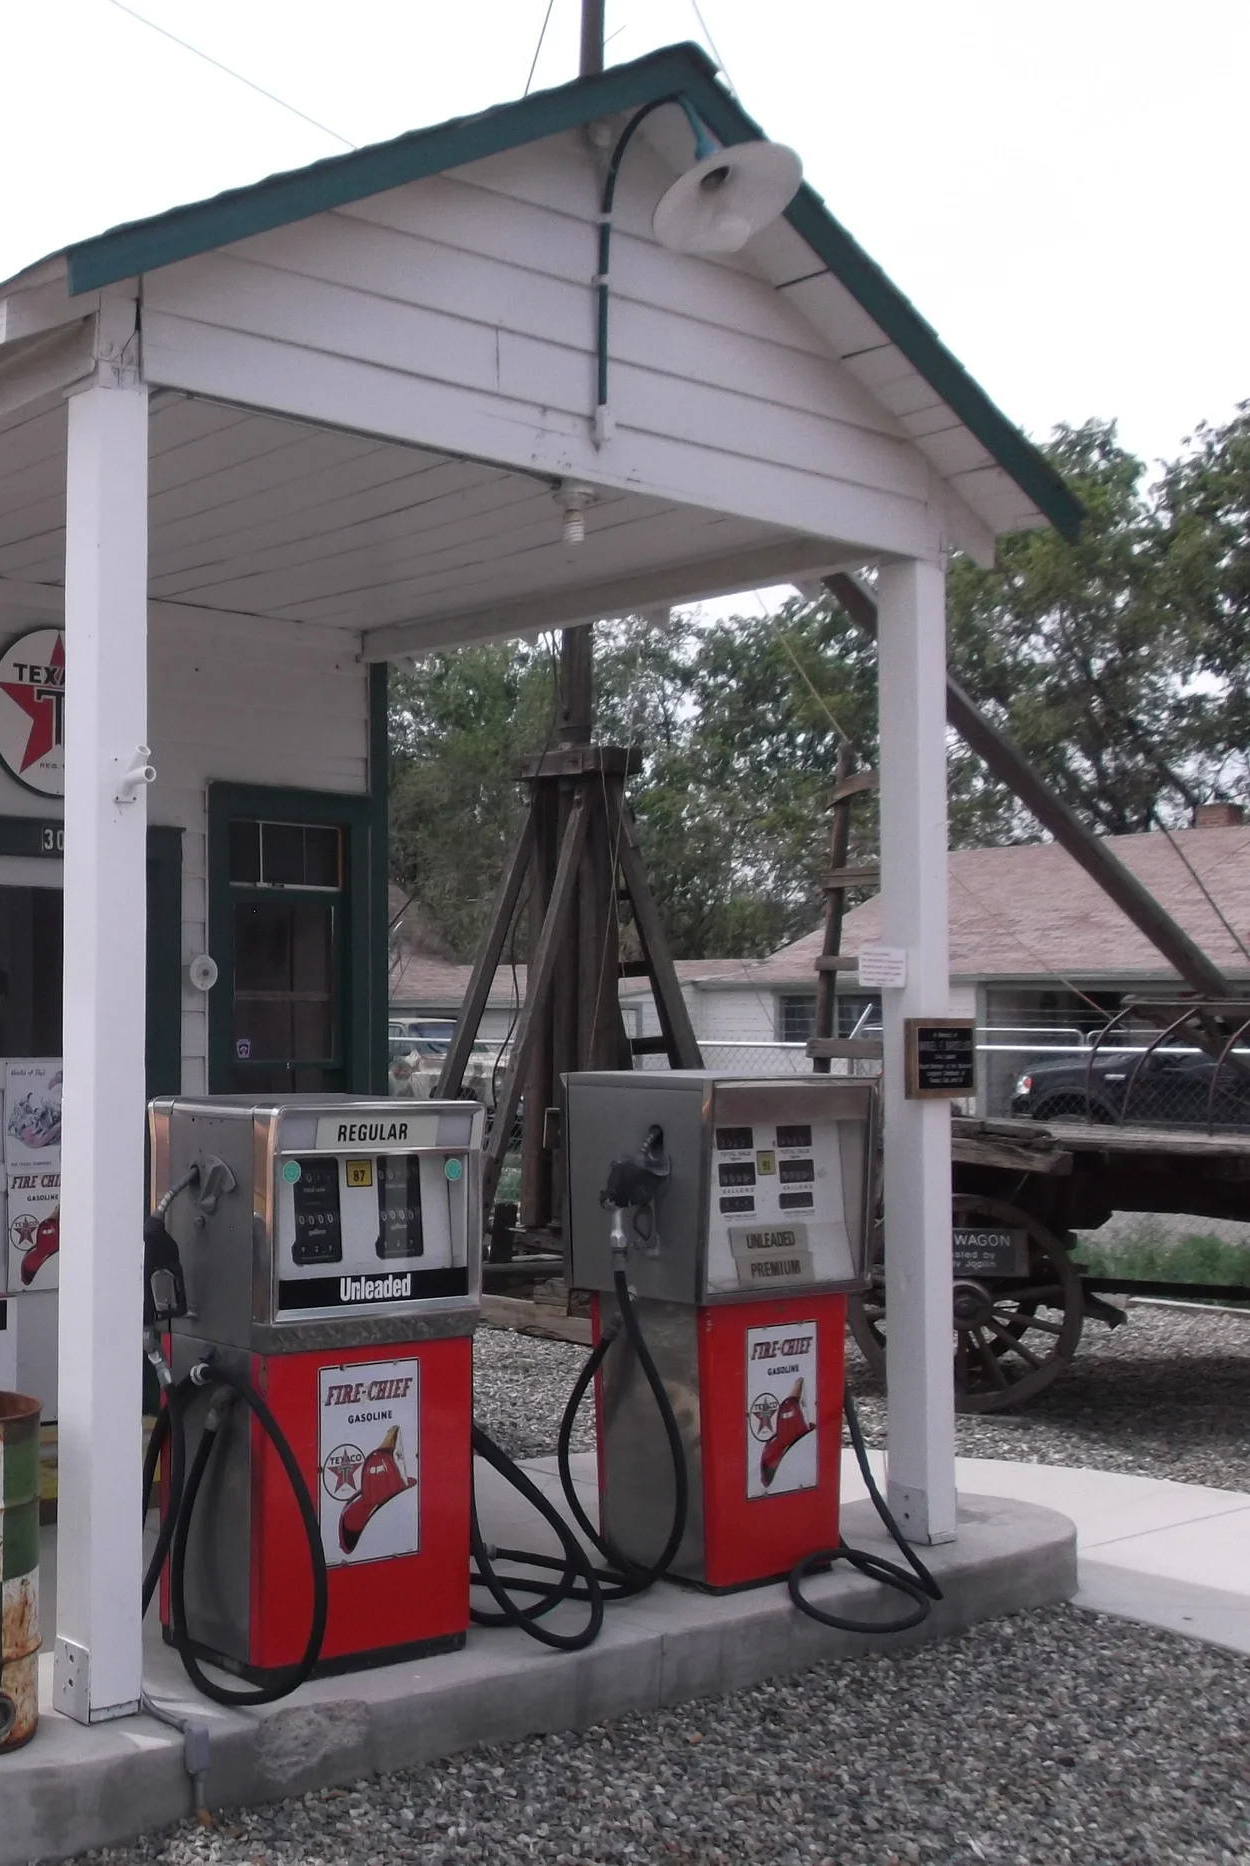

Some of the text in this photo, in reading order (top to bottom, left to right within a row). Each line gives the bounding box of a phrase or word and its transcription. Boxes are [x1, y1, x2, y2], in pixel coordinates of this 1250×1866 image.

[338, 1123, 408, 1142] REGULAR
[11, 1176, 38, 1189] FIRE
[353, 1170, 366, 1182] 87
[746, 1231, 795, 1249] UNLEADED
[954, 1234, 1010, 1246] WAGON
[751, 1259, 801, 1277] PREMIUM
[340, 1273, 412, 1301] Unleaded
[751, 1337, 814, 1360] FIRE-CHIEF
[767, 1364, 799, 1376] GASOLINE
[325, 1377, 413, 1406] FIRE-CHIEF
[754, 1402, 778, 1411] TECO
[348, 1410, 393, 1424] GASOLINE
[330, 1454, 362, 1465] TEXACO
